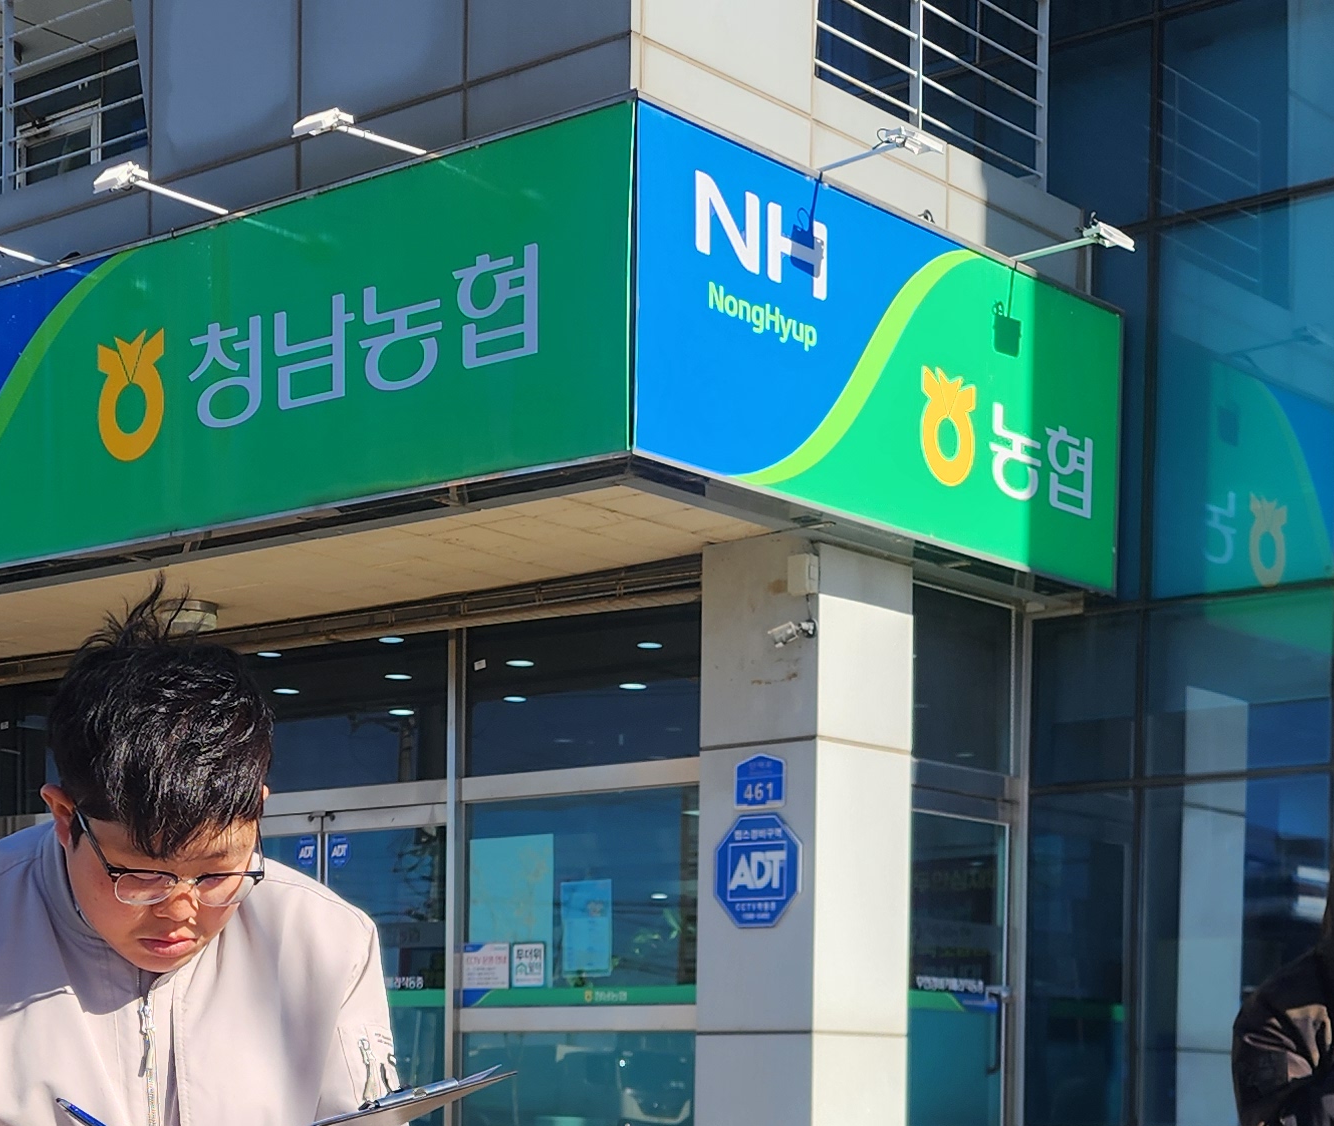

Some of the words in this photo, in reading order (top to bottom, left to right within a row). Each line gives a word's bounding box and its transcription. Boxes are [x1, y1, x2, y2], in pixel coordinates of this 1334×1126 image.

[694, 169, 828, 301] NH
[188, 242, 540, 430] 청남농협
[708, 281, 818, 352] NongHyup
[990, 401, 1093, 520] 농협
[743, 782, 774, 801] 461
[728, 850, 787, 891] ADT
